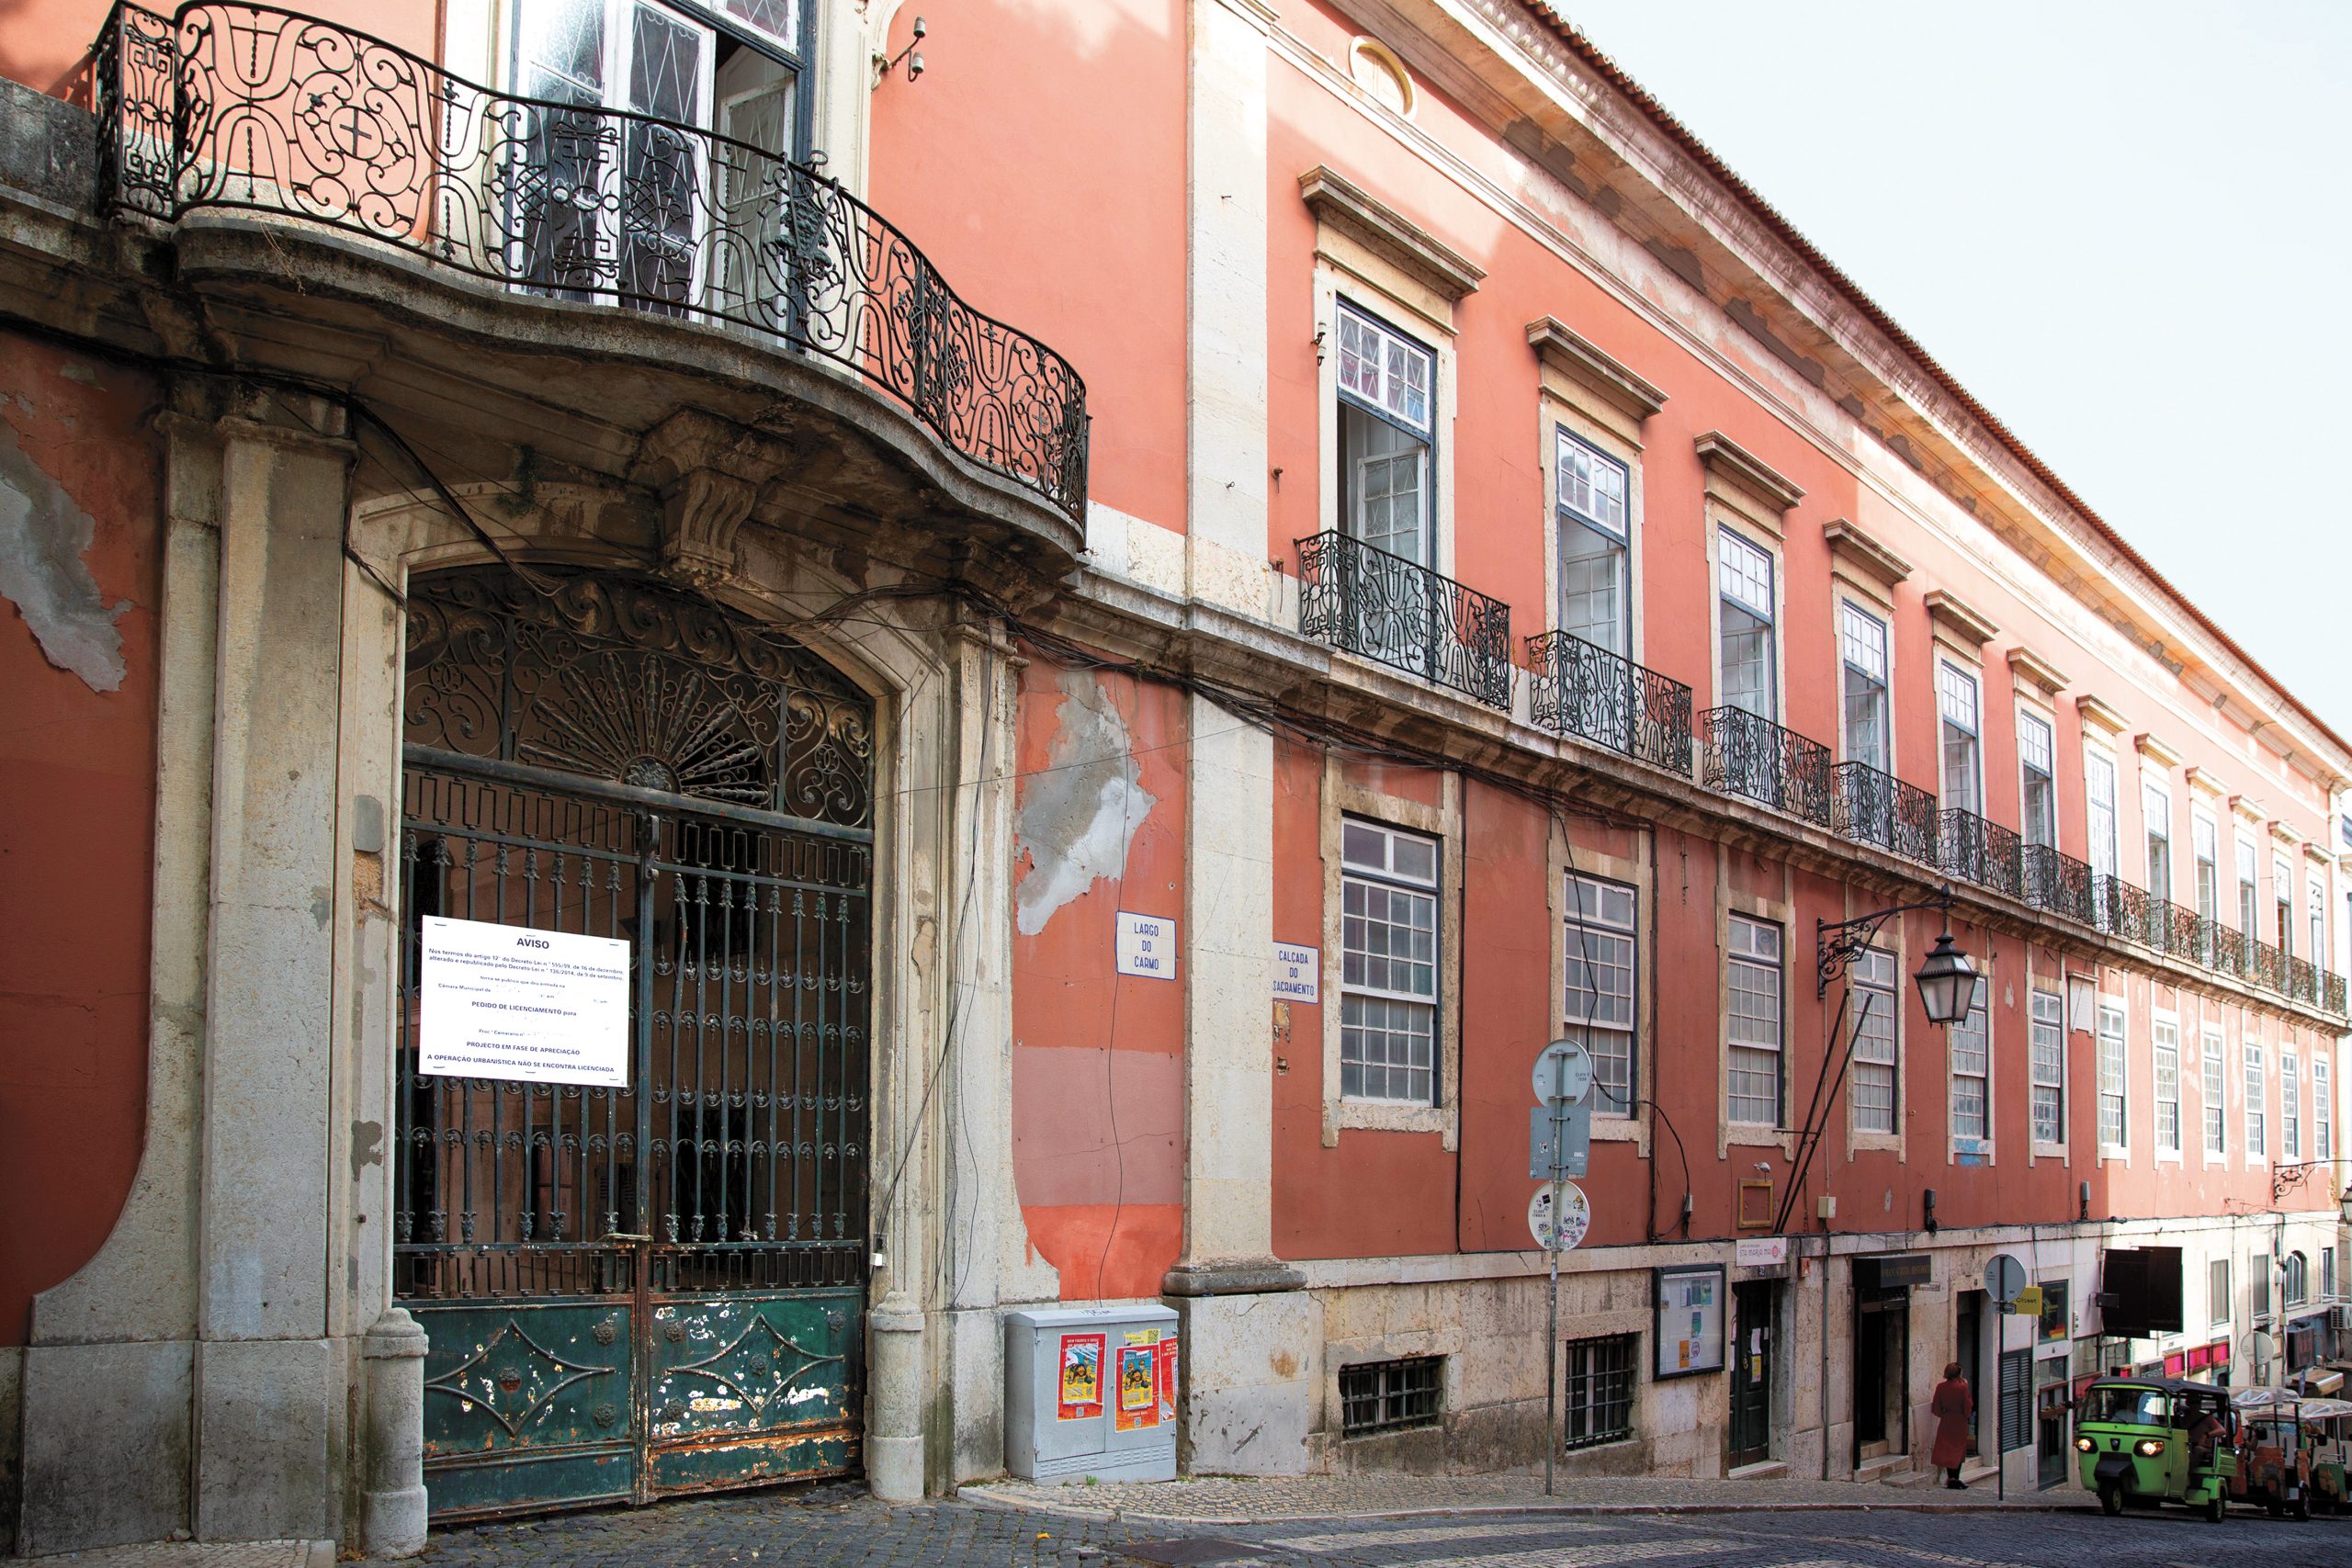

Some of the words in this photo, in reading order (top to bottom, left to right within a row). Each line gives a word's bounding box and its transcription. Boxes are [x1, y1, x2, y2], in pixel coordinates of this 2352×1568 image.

[1134, 921, 1159, 937] LARGO
[516, 938, 549, 949] AVISO
[1141, 940, 1152, 953] DO
[1134, 955, 1159, 970] CARMO
[1289, 967, 1298, 979] DO
[1272, 980, 1315, 996] SACRAMENTO
[509, 1005, 562, 1014] LICENCIAMENTO
